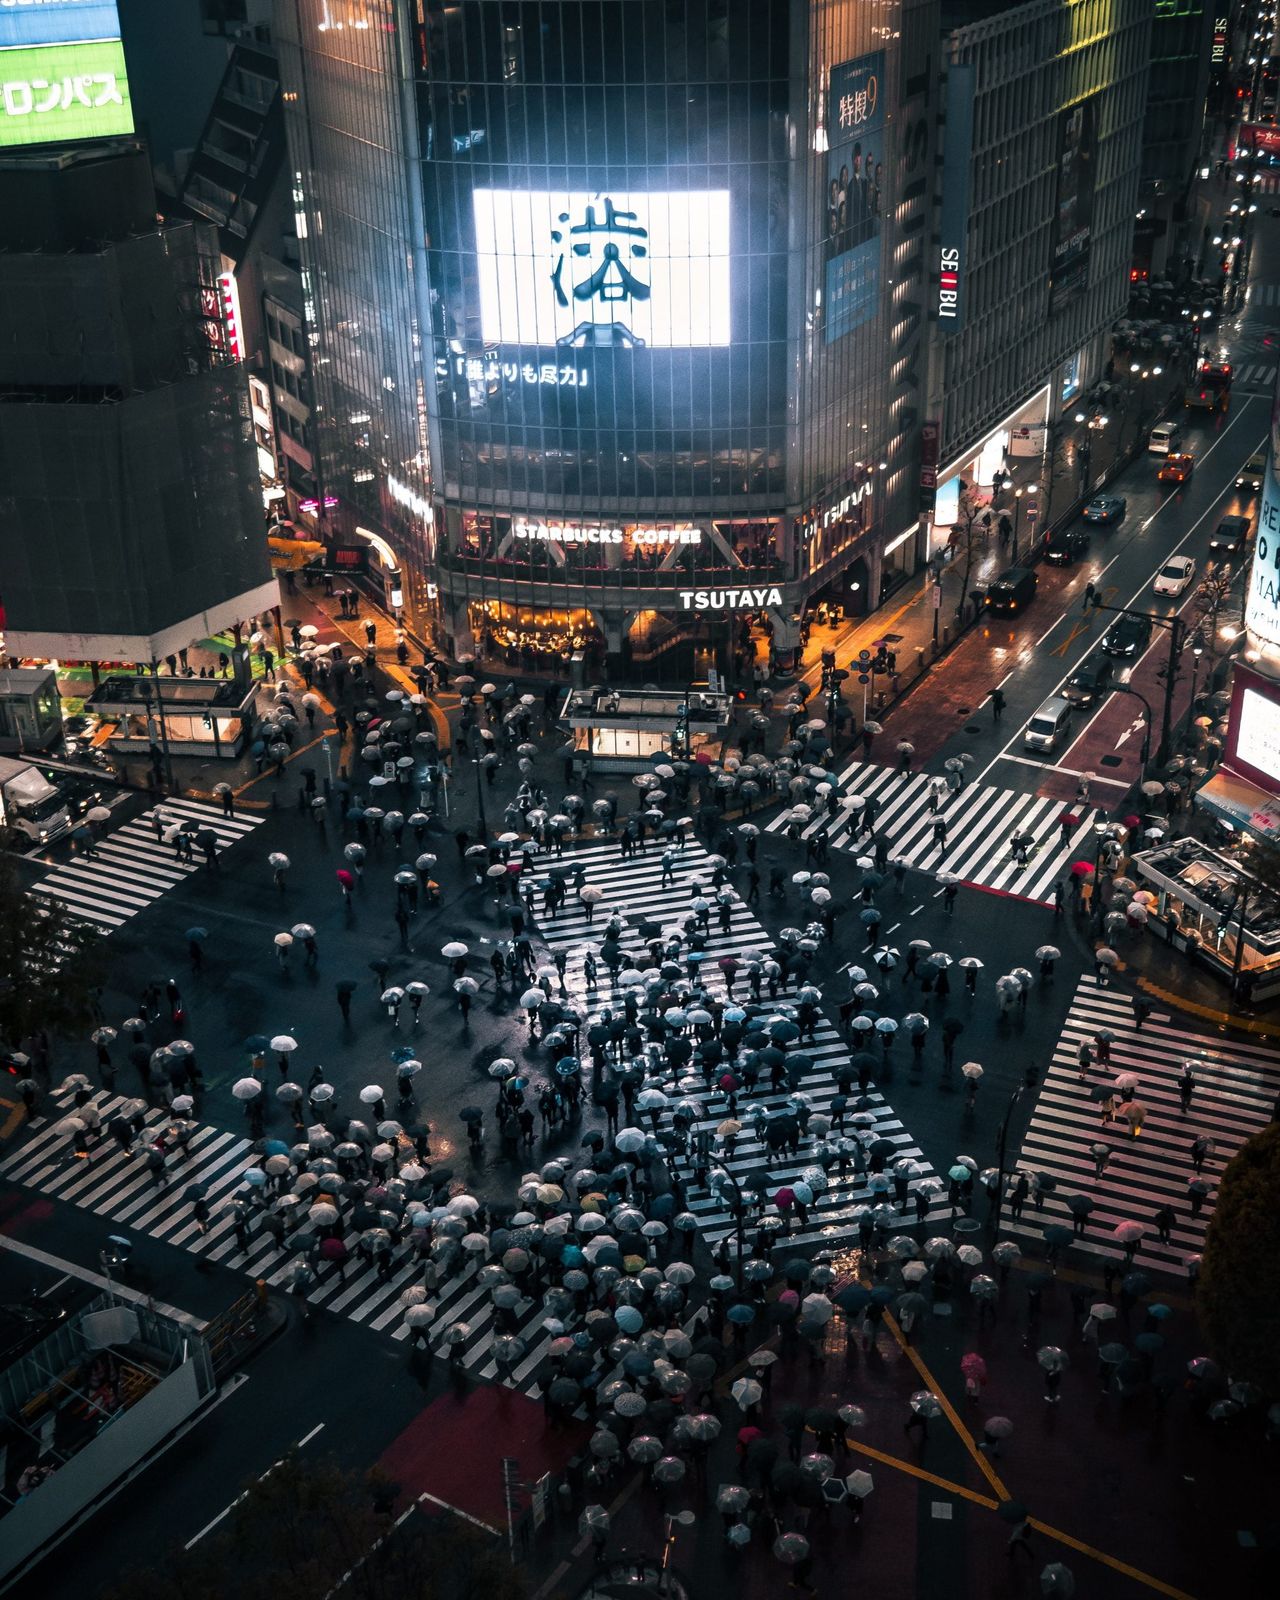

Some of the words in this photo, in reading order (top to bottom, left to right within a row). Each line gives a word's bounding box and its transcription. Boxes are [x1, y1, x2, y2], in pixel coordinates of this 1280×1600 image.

[1211, 18, 1227, 63] SEIBU
[0, 73, 124, 116] ロンパス
[938, 247, 959, 317] SEIBU
[515, 524, 623, 544] STARBUCKS
[632, 528, 702, 545] COFFEE
[1262, 500, 1280, 534] RE
[679, 587, 782, 609] TSUTAYA
